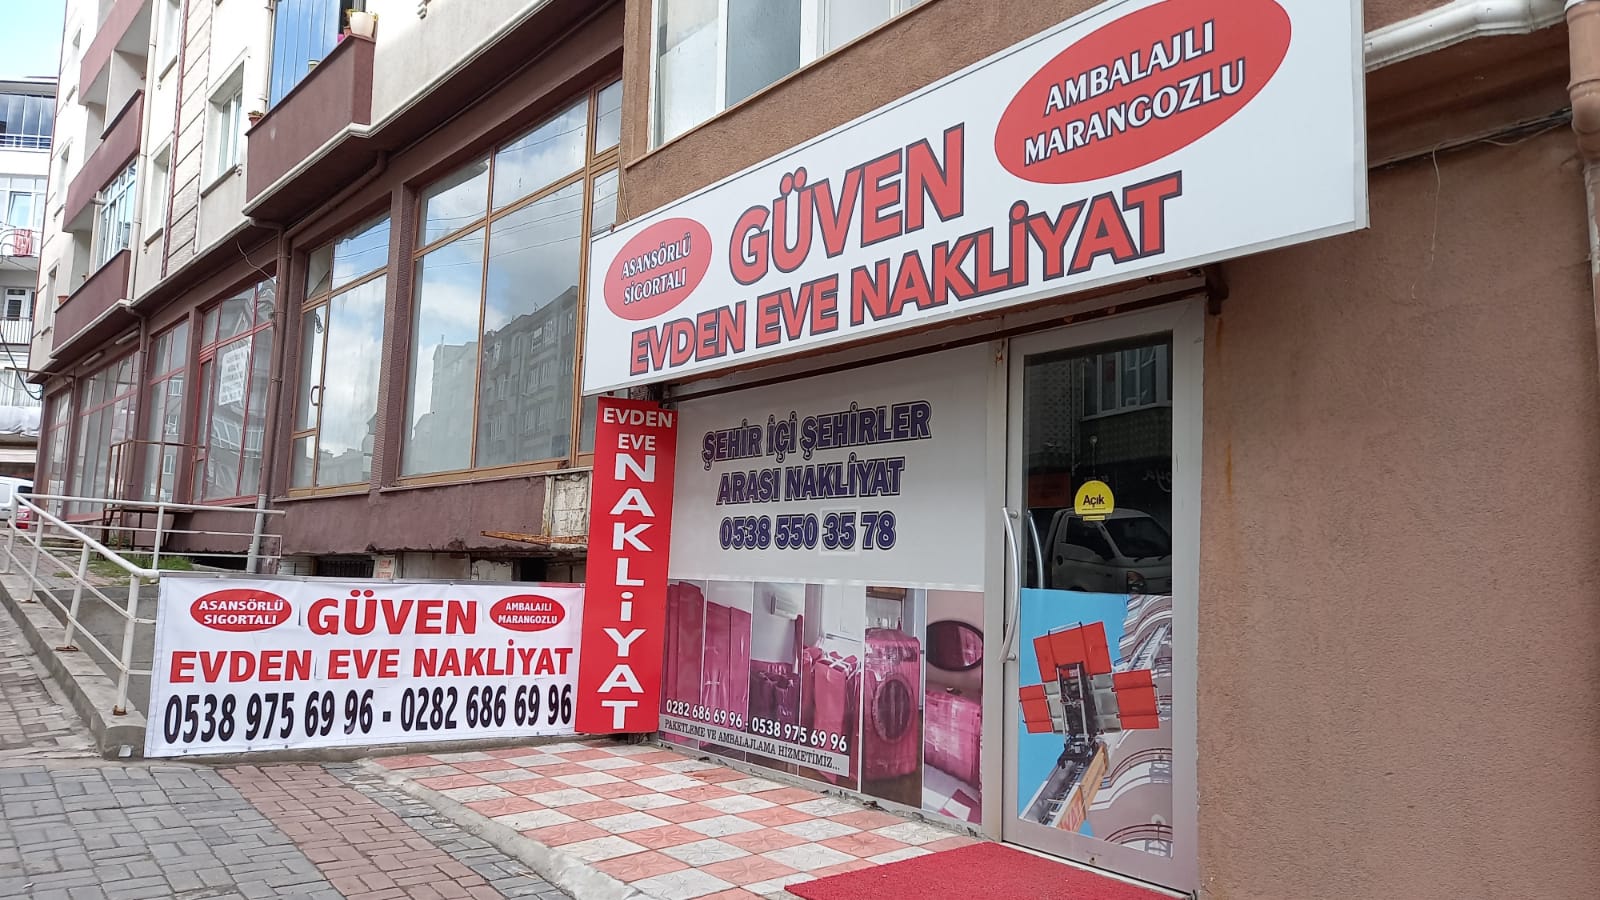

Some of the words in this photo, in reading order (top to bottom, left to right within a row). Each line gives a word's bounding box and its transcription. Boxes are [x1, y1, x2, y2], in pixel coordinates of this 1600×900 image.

[1044, 19, 1215, 117] AMBALAJLI
[1023, 57, 1245, 167] MARANGOZLU
[728, 122, 965, 286] GÜVEN
[621, 232, 691, 280] ASANSÖRLÜ
[630, 300, 746, 376] EVDEN
[756, 273, 839, 348] EVE
[850, 170, 1182, 326] NAKLİYAT
[624, 266, 686, 305] SİGORTALI
[603, 407, 673, 428] EVDEN
[702, 418, 763, 471] ŞEHİR
[766, 410, 797, 463] İÇİ
[800, 401, 932, 460] ŞEHİRLER
[618, 433, 656, 451] EVE
[716, 467, 781, 505] ARASI
[784, 452, 905, 501] NAKLİYAT
[1083, 494, 1105, 507] Açık
[719, 515, 771, 550] 0538
[774, 513, 819, 549] 550
[822, 512, 856, 549] 35
[860, 510, 896, 550] 78
[198, 598, 284, 611] ASANSÖRLÜ
[203, 614, 277, 625] SIGORTALI
[307, 589, 477, 636] GÜVEN
[498, 614, 558, 624] MARANGOZLU
[505, 602, 552, 612] AMBALAJLI
[169, 650, 313, 684] EVDEN
[327, 648, 399, 679] EVE
[413, 639, 573, 678] NAKLİYAT
[164, 693, 237, 745] 0538
[245, 692, 295, 741] 975
[304, 690, 335, 738] 69
[343, 689, 374, 735] 96
[382, 711, 391, 723] -
[400, 686, 458, 732] 0282
[465, 685, 506, 729] 686
[514, 684, 539, 727] 69
[547, 684, 572, 726] 96
[664, 719, 706, 738] PAKETLEME
[707, 728, 717, 740] VE
[718, 732, 776, 754] AMBALAJLAMA
[666, 699, 690, 717] 0282
[692, 704, 710, 721] 686
[713, 708, 727, 724] 69
[729, 711, 742, 728] 96
[752, 717, 781, 737] 0538
[784, 723, 807, 743] 975
[811, 730, 827, 747] 69
[831, 733, 847, 752] 96
